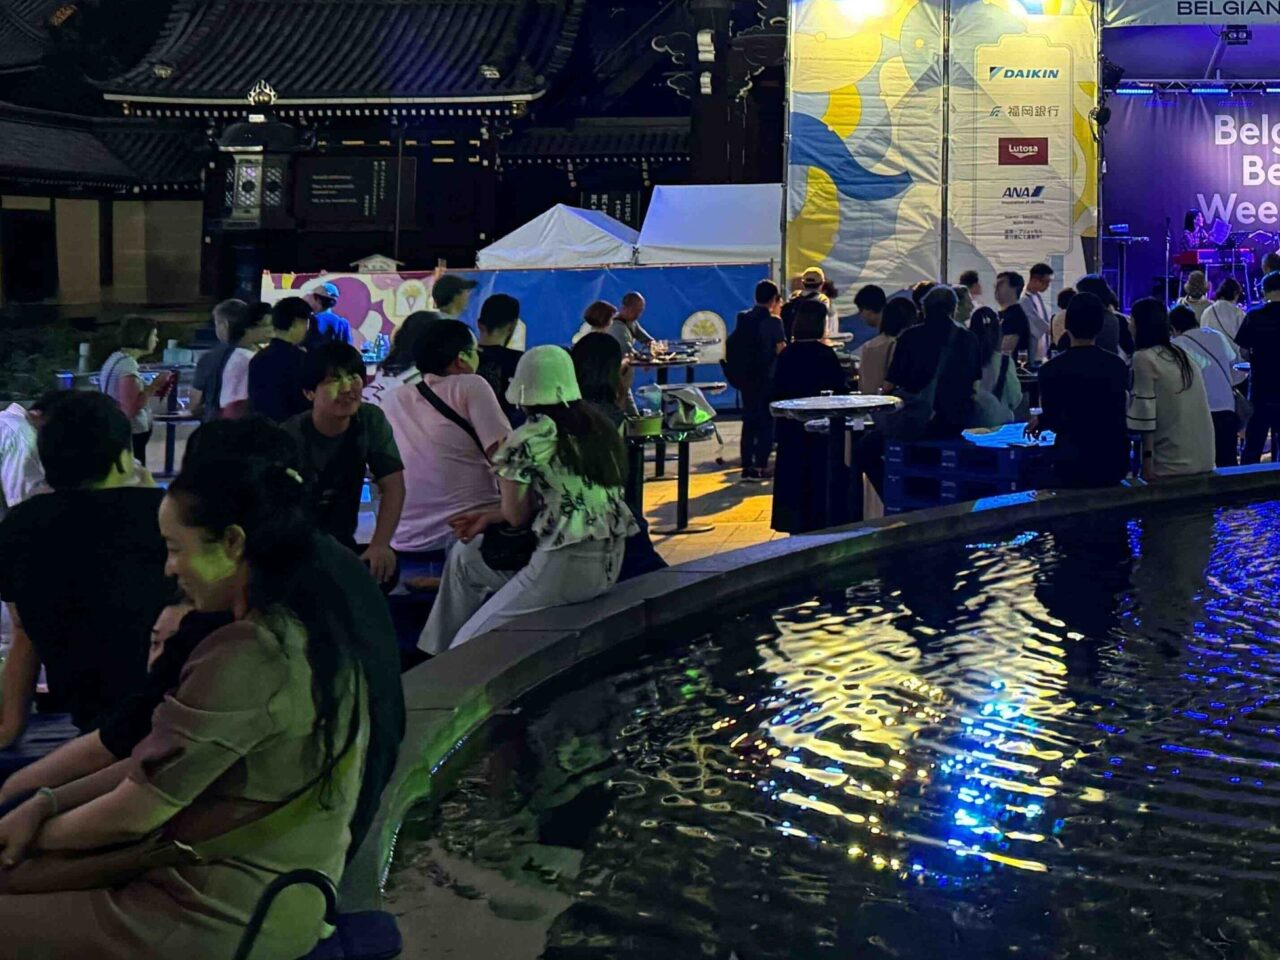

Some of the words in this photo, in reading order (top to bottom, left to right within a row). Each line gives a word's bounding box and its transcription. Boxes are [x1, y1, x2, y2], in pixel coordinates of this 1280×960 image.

[1003, 69, 1059, 79] DAIKIN
[1008, 105, 1059, 117] 福岡銀行
[1008, 144, 1038, 153] Lutosa
[1002, 187, 1030, 198] ANA
